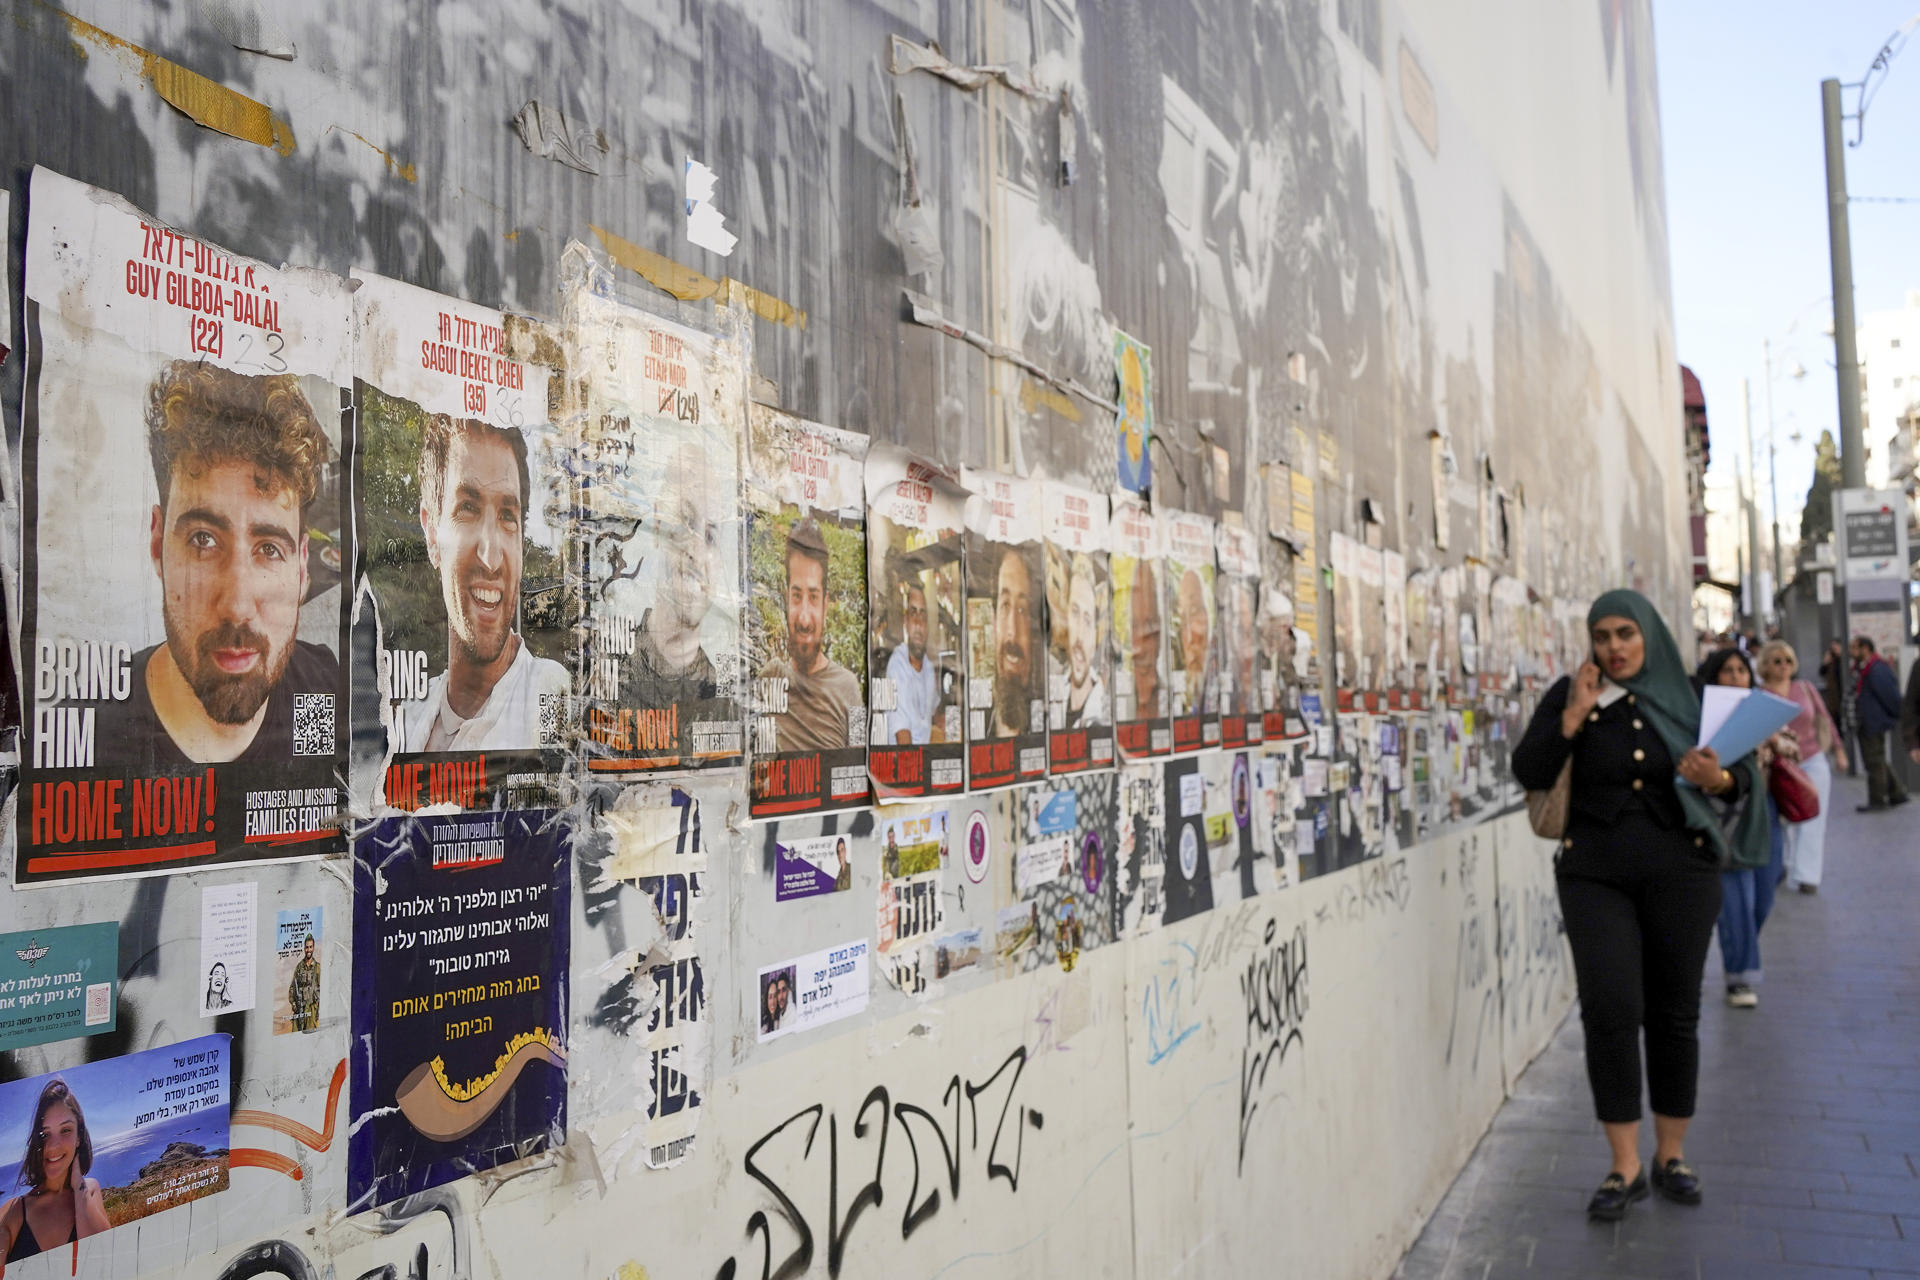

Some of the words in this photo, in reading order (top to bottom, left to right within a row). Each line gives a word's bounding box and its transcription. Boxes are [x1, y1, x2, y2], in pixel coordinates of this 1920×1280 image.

[126, 260, 161, 301] GUY
[166, 271, 282, 333] GILBOA-DALAL
[190, 314, 224, 359] (22)
[438, 311, 452, 343] חן
[454, 314, 478, 349] דקל
[421, 340, 457, 376] SAGUI
[460, 349, 494, 384] DEKEL
[495, 359, 524, 391] CHEN
[644, 355, 668, 385] EITAN
[669, 362, 687, 390] MOR
[463, 380, 487, 417] (35)
[494, 386, 525, 428] 36
[677, 389, 700, 425] (24)
[34, 638, 133, 702] BRING
[636, 704, 678, 751] NOW!
[33, 707, 96, 769] HIM
[429, 754, 487, 809] NOW!
[788, 752, 821, 794] NOW!
[31, 780, 124, 845] HOME
[132, 768, 218, 838] NOW!
[246, 791, 287, 810] HOSTAGES
[286, 790, 304, 807] AND
[304, 787, 338, 806] MISSING
[245, 808, 298, 836] FAMILIES
[432, 842, 470, 866] והנעדרים
[470, 839, 505, 862] החטופים
[454, 888, 497, 914] מלפניך
[500, 888, 523, 908] רצון
[526, 884, 547, 901] "יהי
[385, 896, 435, 921] אלוהינו,
[438, 896, 450, 912] ה'
[301, 913, 310, 921] את
[515, 912, 549, 933] ואלוהי
[280, 921, 313, 935] השמחה
[419, 924, 465, 946] שתגזור
[468, 917, 512, 938] אבותינו
[283, 940, 293, 950] לא
[383, 930, 417, 951] עלינו
[20, 948, 43, 961] 5030
[429, 953, 472, 975] טובות"
[475, 948, 510, 968] גזירות
[18, 974, 51, 990] לעלות
[53, 971, 82, 985] בחרנו
[516, 974, 541, 994] בחג
[44, 990, 65, 1005] ניתן
[67, 986, 82, 999] לא
[433, 985, 486, 1011] מחזירים
[490, 980, 513, 998] הזה
[802, 989, 818, 1005] אדם
[819, 981, 833, 998] לכל
[19, 992, 42, 1009] לאף
[392, 995, 430, 1019] אותם
[445, 1015, 493, 1041] הביתה!
[173, 1056, 186, 1069] של
[186, 1053, 206, 1066] שמש
[207, 1049, 219, 1063] קרן
[166, 1069, 198, 1086] אינסופית
[199, 1064, 219, 1077] אהבה
[146, 1078, 164, 1091] שלנו
[187, 1086, 195, 1096] בו
[196, 1079, 220, 1095] במקום
[164, 1087, 187, 1102] עמדת
[201, 1094, 219, 1107] נשאר
[156, 1107, 169, 1119] בלי
[170, 1102, 188, 1117] אויר,
[188, 1099, 199, 1115] רק
[133, 1111, 155, 1129] חמצן.
[162, 1176, 186, 1190] 7.10.23
[191, 1179, 209, 1190] נשכח
[209, 1174, 219, 1184] לא
[175, 1184, 191, 1198] אותך
